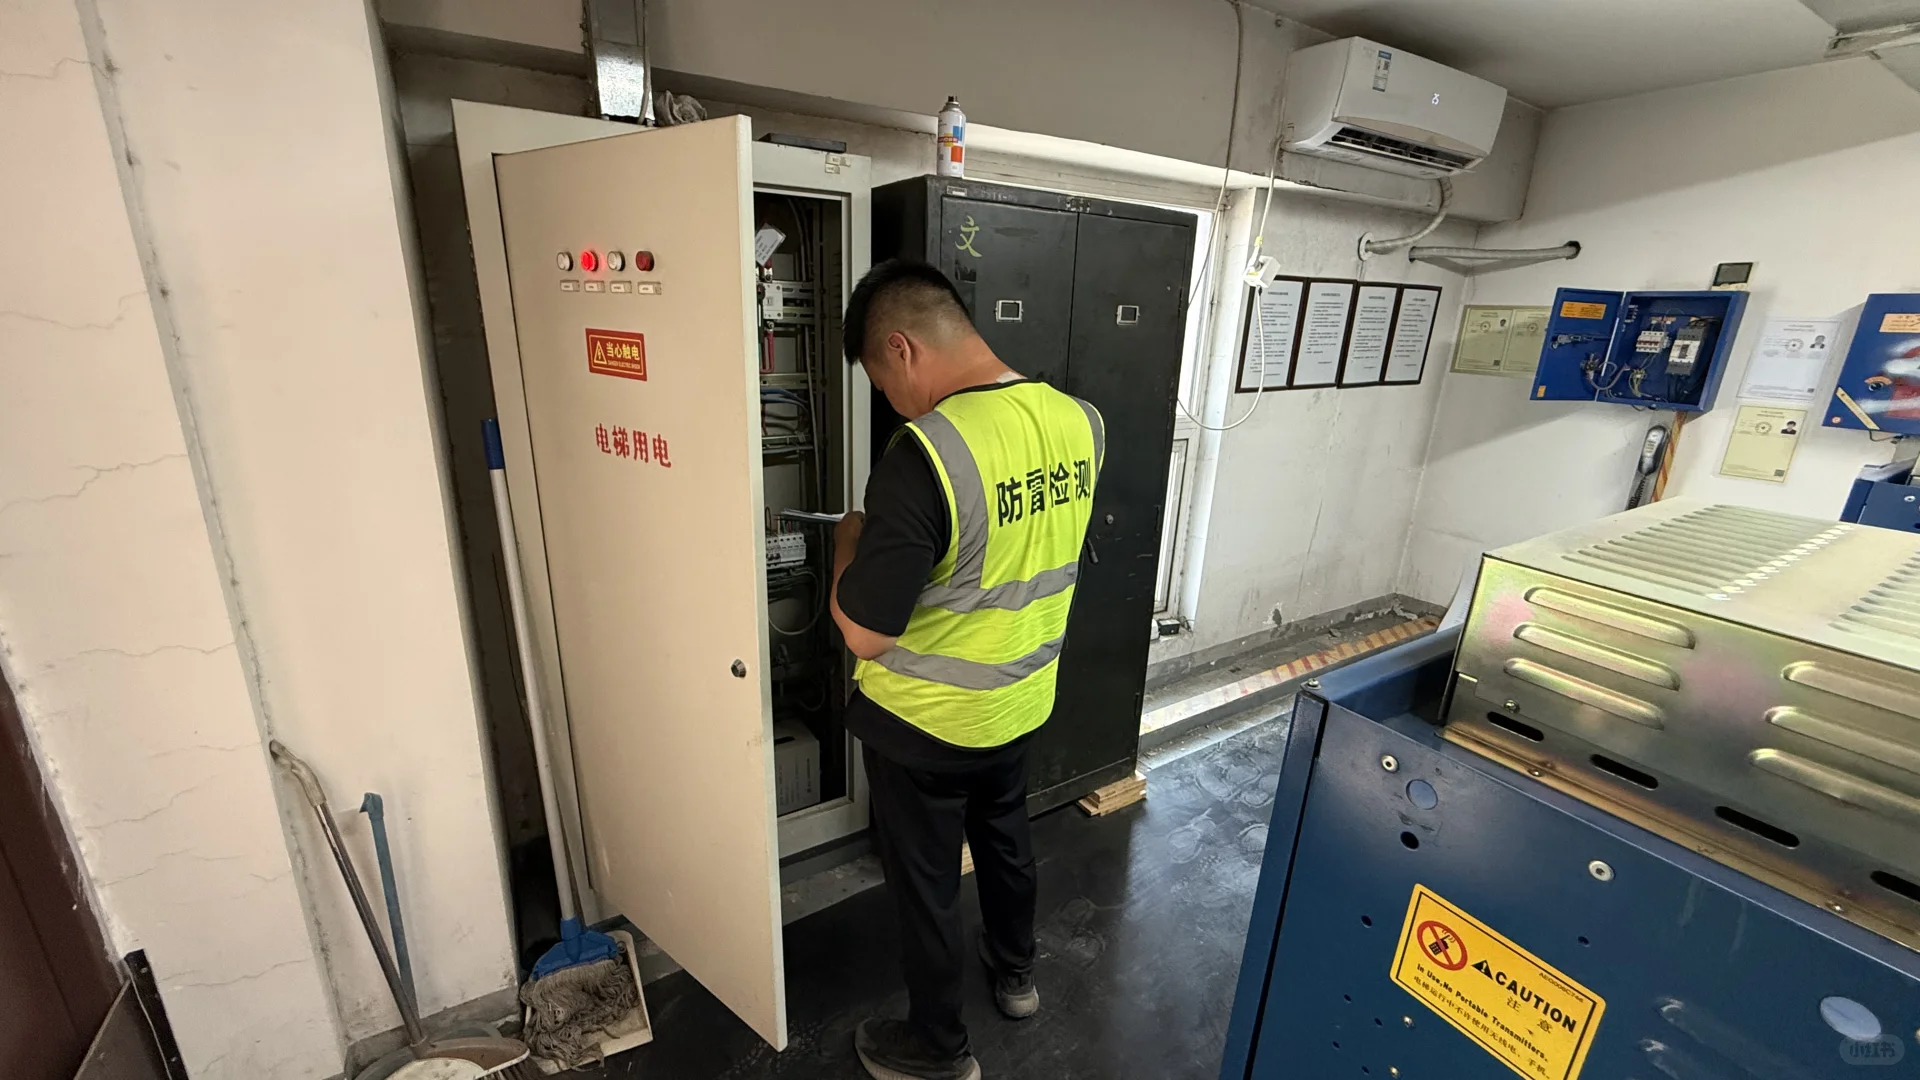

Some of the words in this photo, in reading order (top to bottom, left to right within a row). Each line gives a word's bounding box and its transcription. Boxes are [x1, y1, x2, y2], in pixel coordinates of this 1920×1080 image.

[955, 215, 982, 258] 文
[606, 341, 640, 361] 当心触电
[595, 423, 671, 468] 电梯用电
[1417, 963, 1425, 973] In
[1455, 990, 1488, 1018] Portable
[1492, 1015, 1549, 1062] Transmitters.
[1495, 971, 1577, 1033] CAUTION
